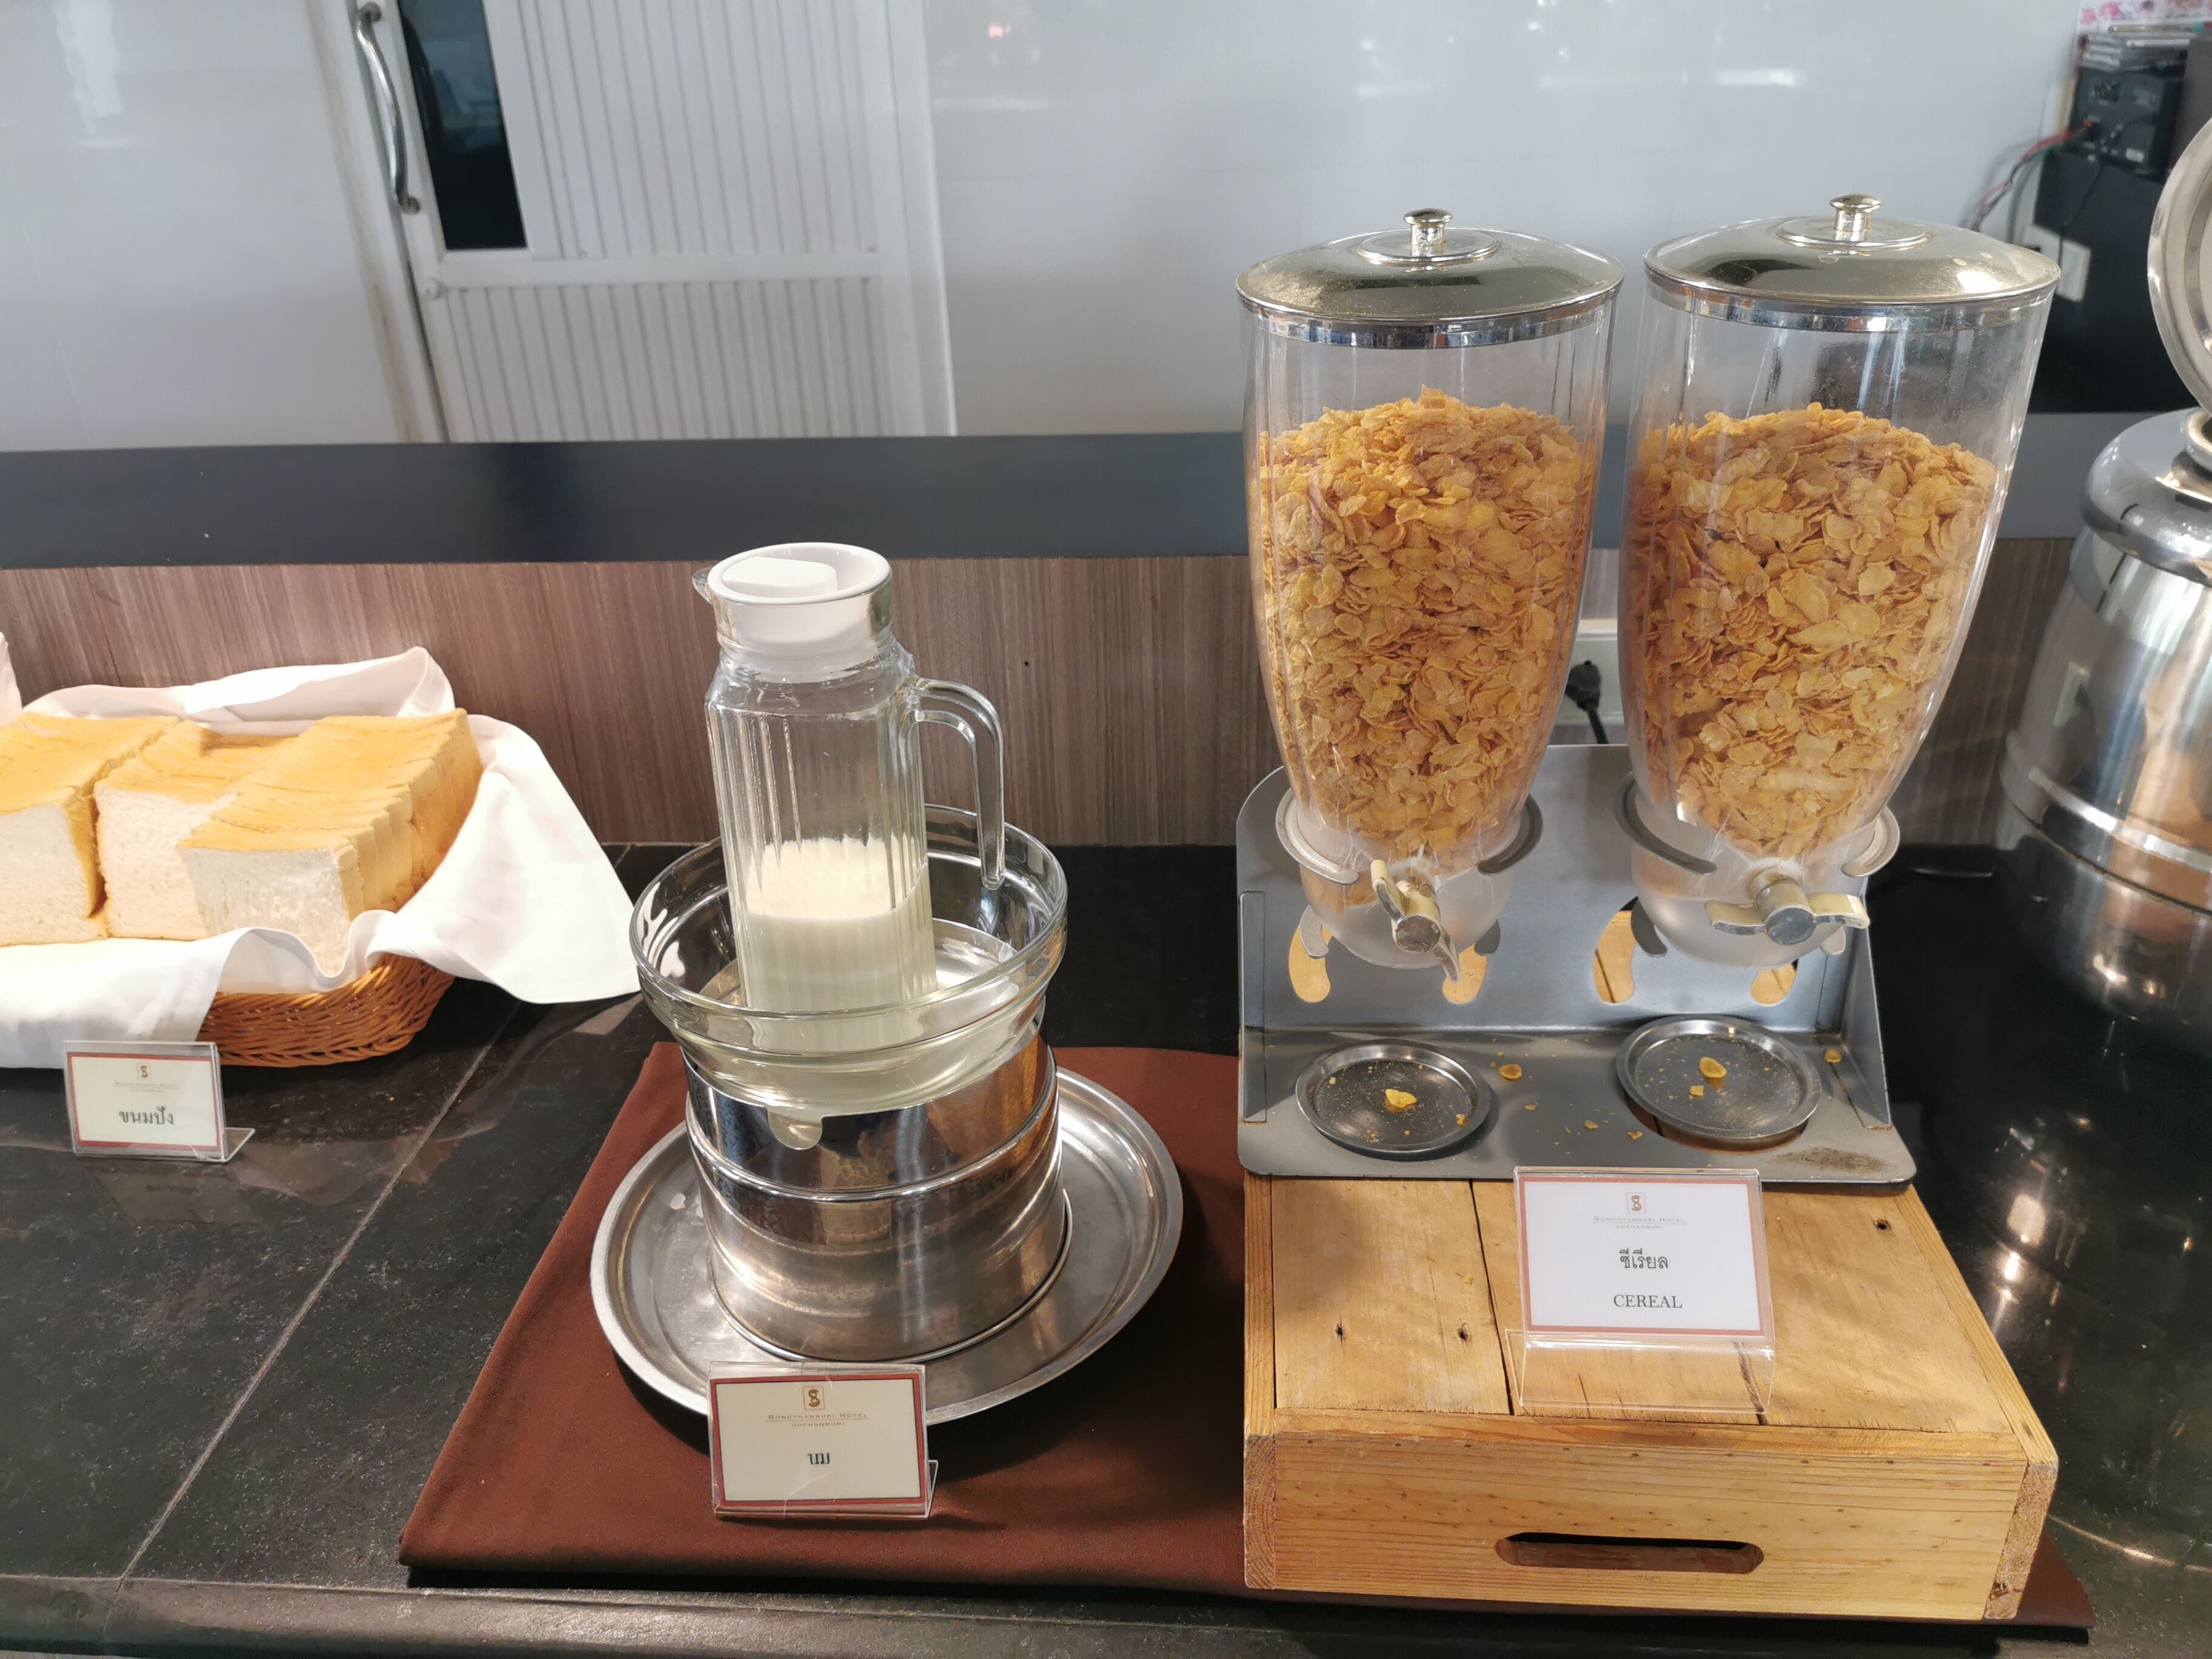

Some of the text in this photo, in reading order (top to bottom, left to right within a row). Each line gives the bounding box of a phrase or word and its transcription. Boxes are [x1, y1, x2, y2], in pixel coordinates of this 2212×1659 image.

[118, 1105, 174, 1125] ขนมปัง
[1619, 1248, 1669, 1269] ซีเรียล
[1613, 1295, 1683, 1309] CEREAL
[807, 1453, 830, 1465] นม
